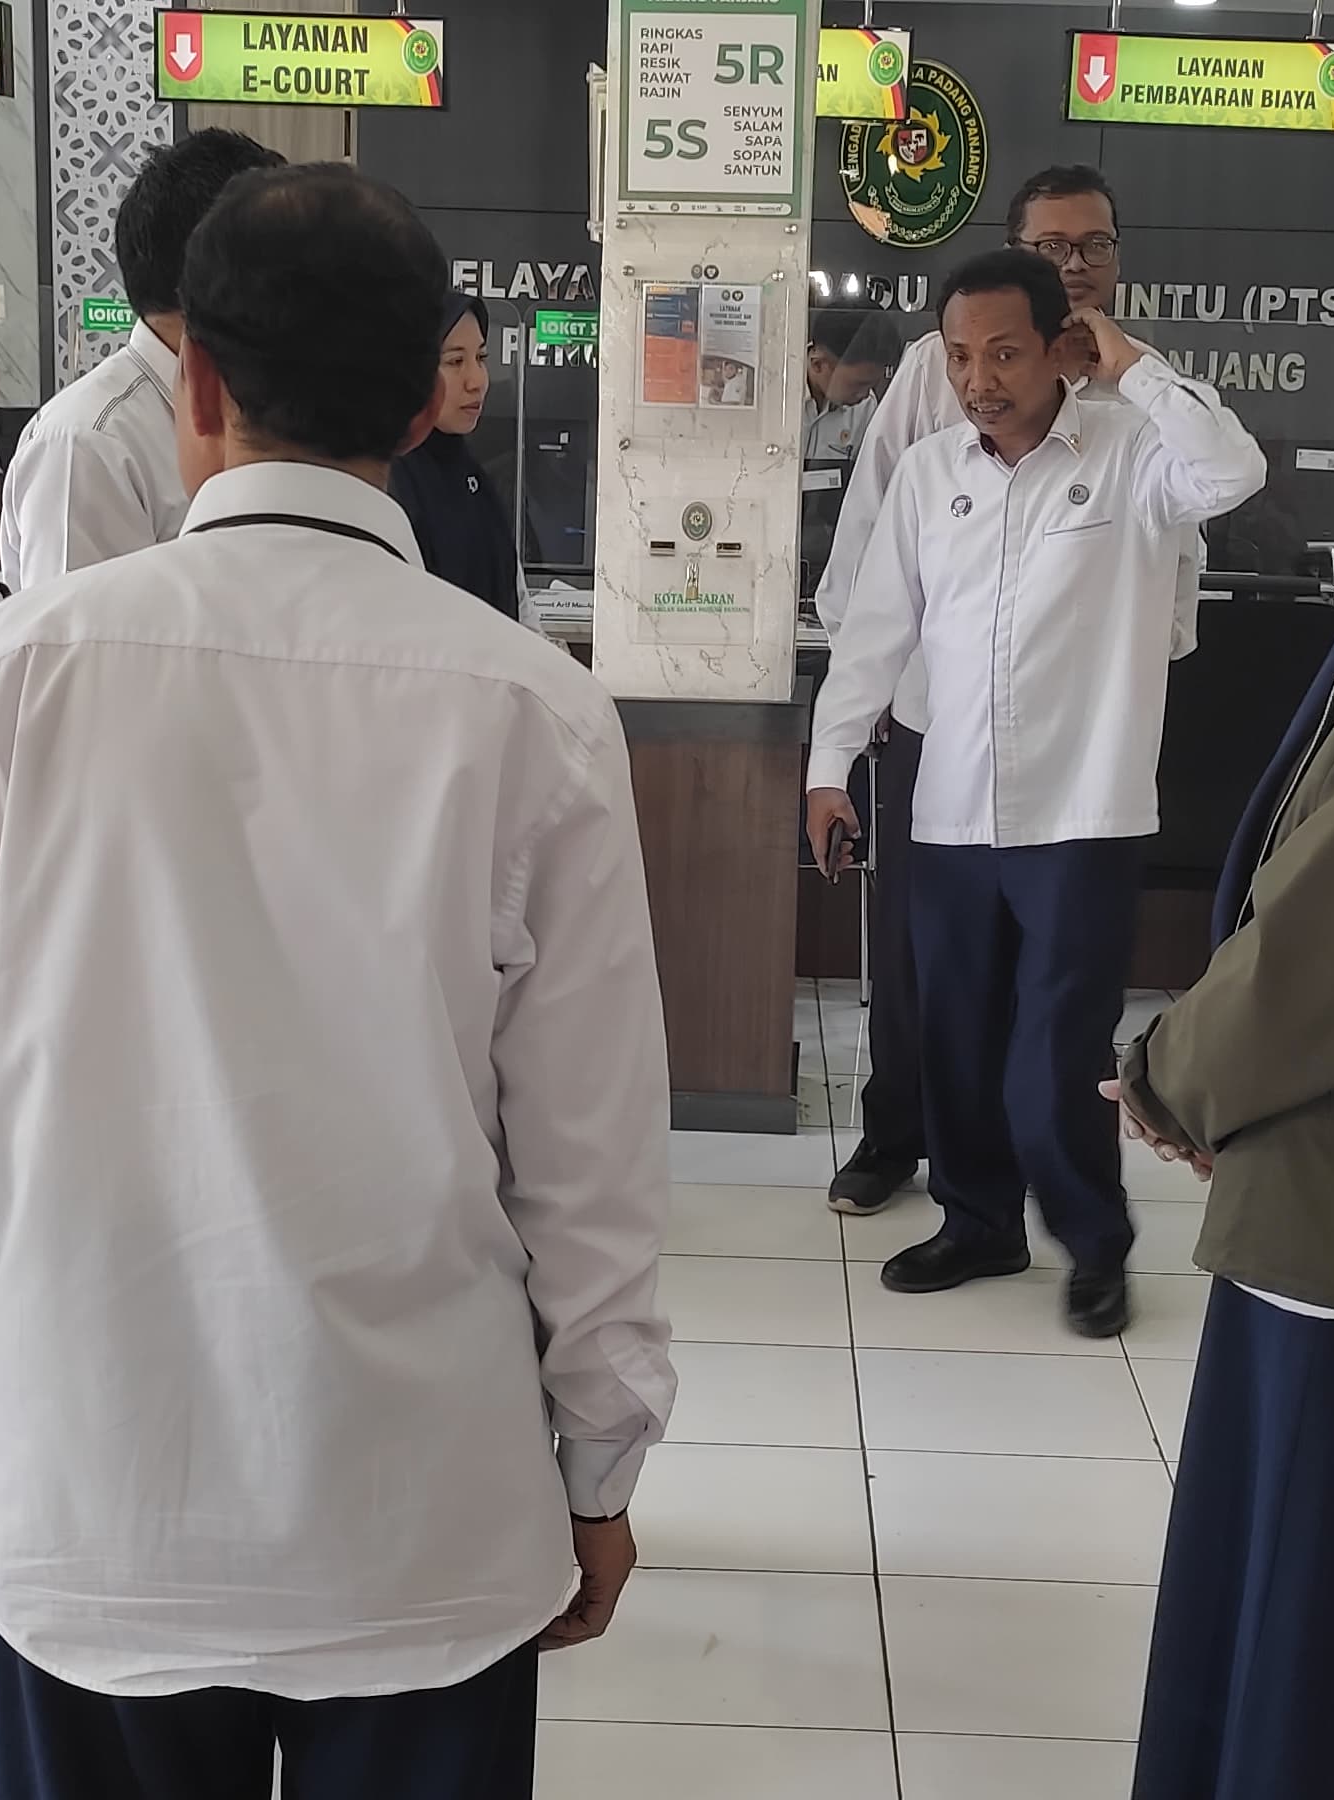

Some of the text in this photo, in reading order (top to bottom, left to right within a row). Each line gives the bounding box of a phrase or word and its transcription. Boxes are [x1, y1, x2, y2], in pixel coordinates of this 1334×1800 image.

[243, 22, 368, 53] LAYANAN
[640, 28, 703, 40] RINGKAS
[640, 43, 673, 54] RAPI
[640, 57, 681, 69] RESIK
[714, 43, 784, 85] 5R
[1177, 56, 1265, 79] LAYANAN
[243, 65, 370, 96] E-COURT
[640, 72, 692, 84] RAWAT
[640, 87, 681, 98] RAJIN
[1121, 84, 1317, 109] PEMBAYARAN BIAYA
[723, 106, 783, 118] SENYUM
[733, 120, 783, 132] SALAM
[928, 69, 972, 117] PADANG
[965, 117, 981, 186] PANJANG
[643, 119, 709, 159] 5S
[745, 135, 782, 147] SAPA
[733, 150, 782, 161] SOPAN
[723, 164, 782, 176] SANTUN
[88, 308, 133, 323] LOKET
[541, 321, 587, 336] LOKET
[697, 593, 735, 605] SARAN
